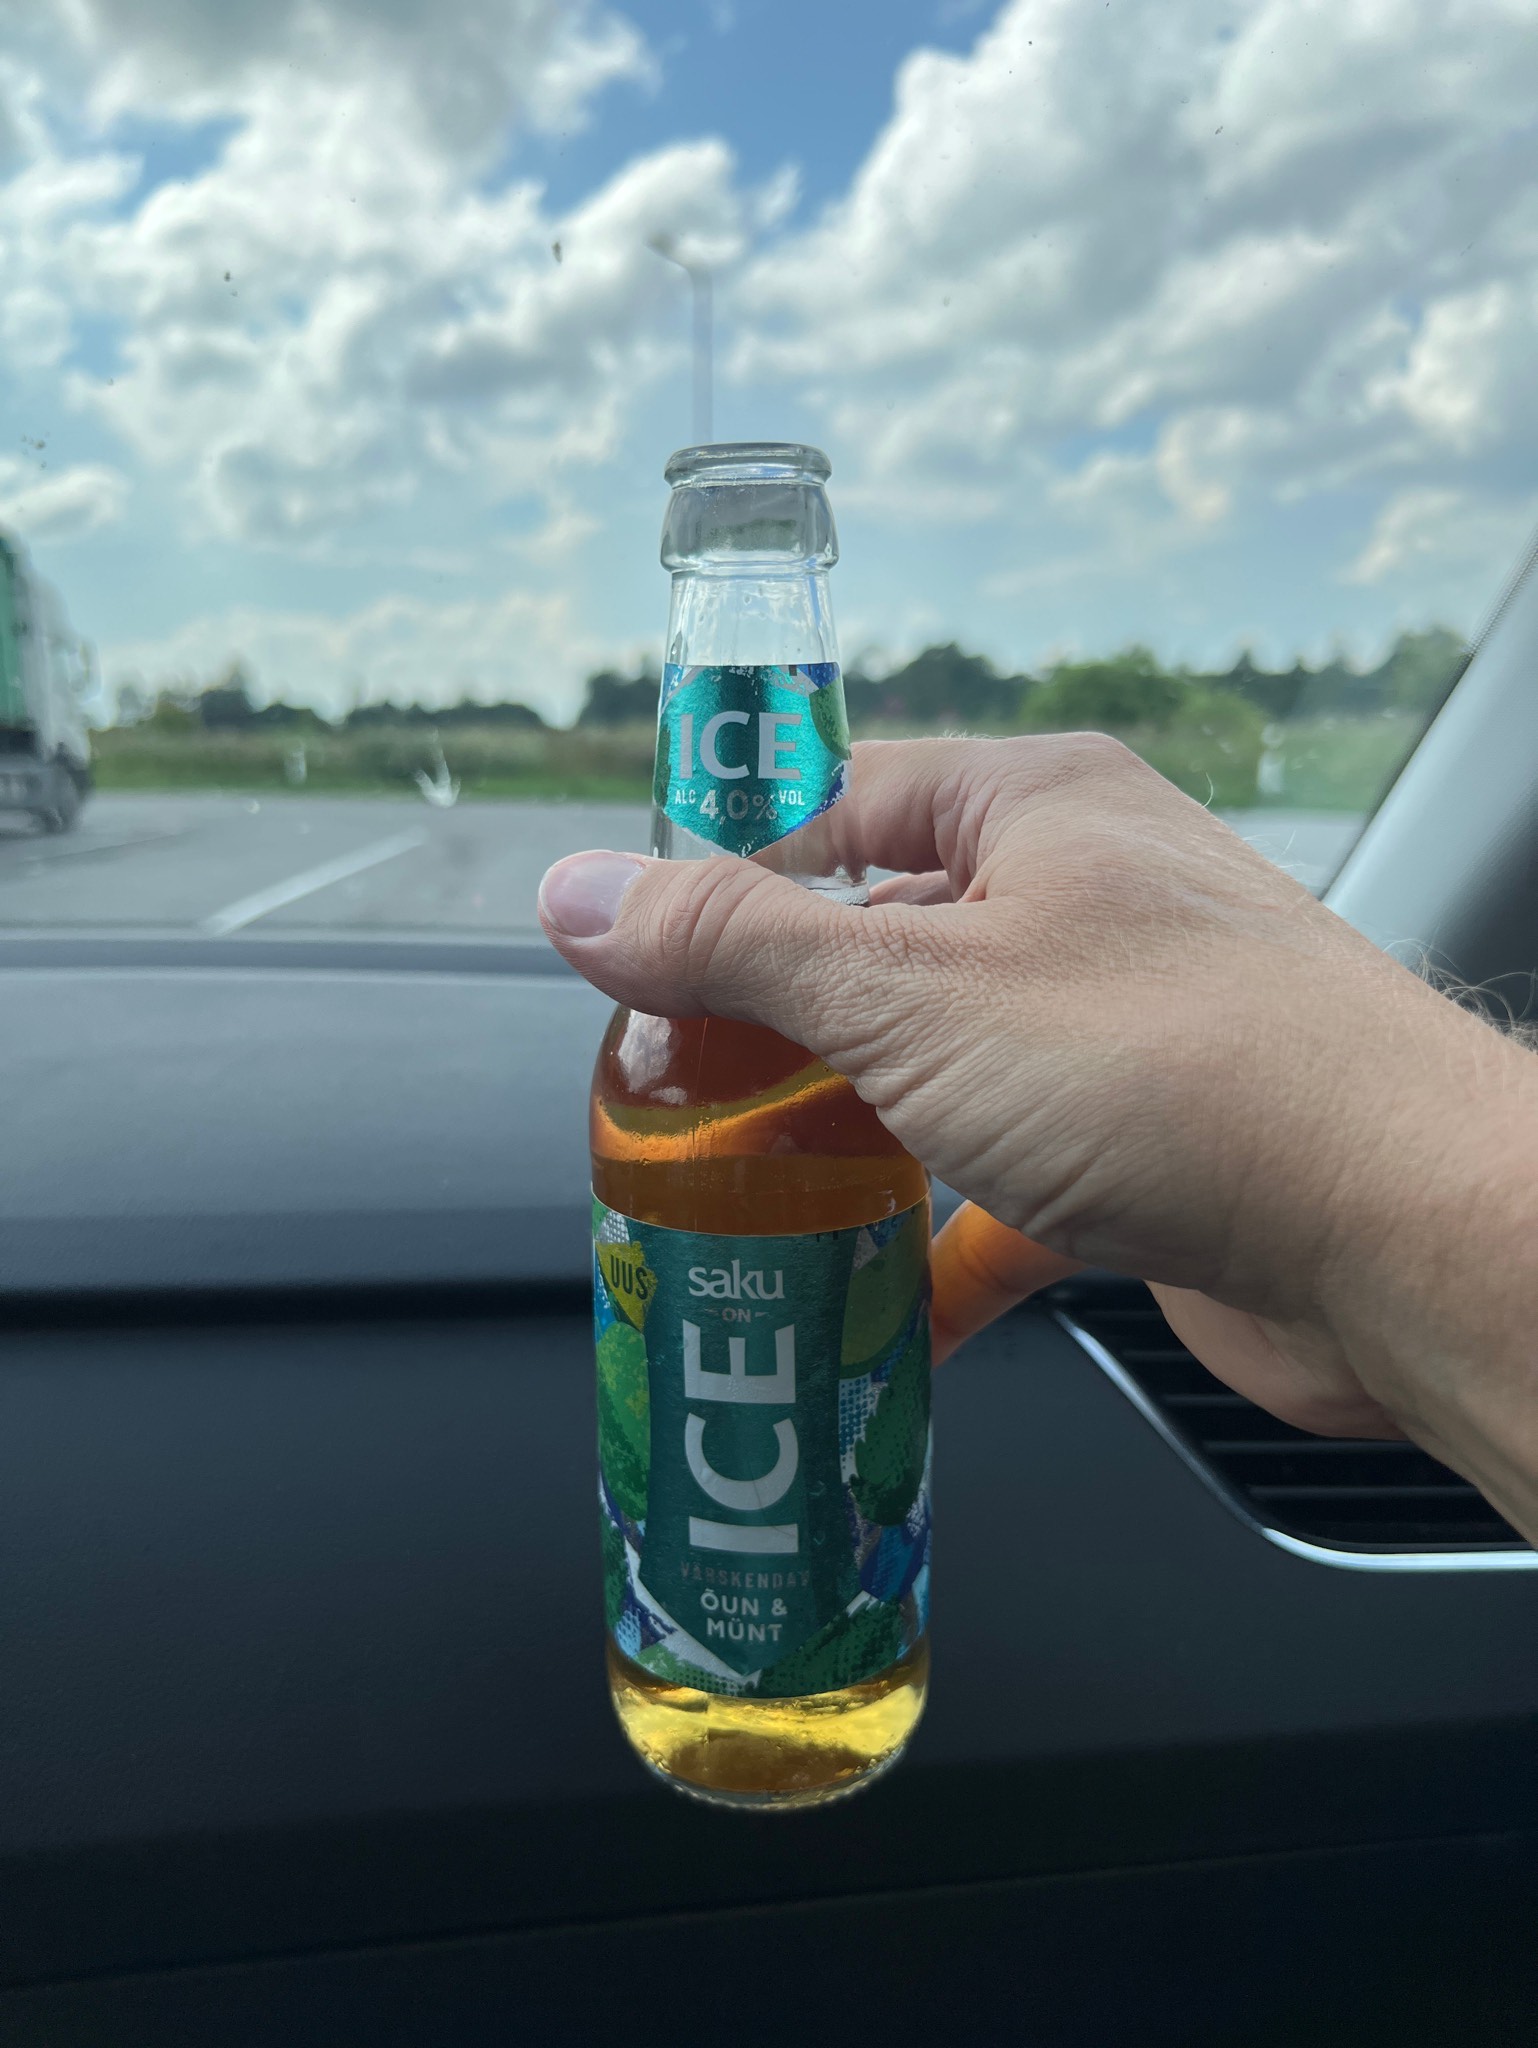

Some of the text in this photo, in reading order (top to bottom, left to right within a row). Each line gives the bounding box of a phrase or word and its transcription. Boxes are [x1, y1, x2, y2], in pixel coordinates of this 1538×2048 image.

[679, 710, 803, 780] ICE
[674, 789, 806, 825] ALC 4,0% VOL
[610, 1254, 649, 1300] UUS
[688, 1258, 786, 1301] saku
[721, 1307, 751, 1323] ON
[682, 1318, 799, 1553] ICE
[700, 1587, 788, 1616] ÕUN &
[706, 1616, 783, 1642] MÜNT
